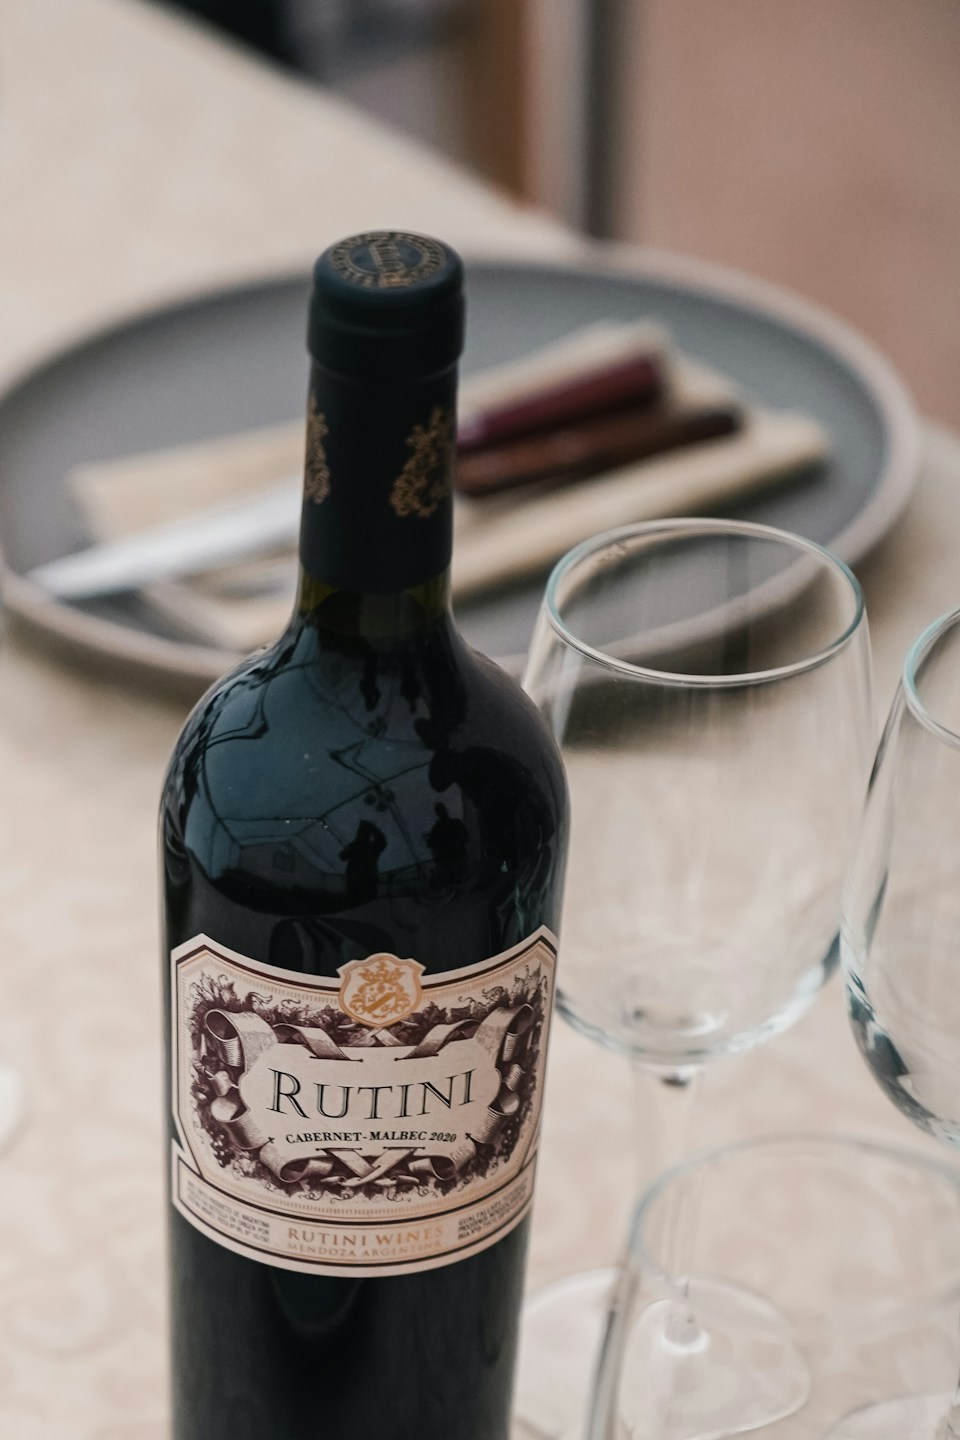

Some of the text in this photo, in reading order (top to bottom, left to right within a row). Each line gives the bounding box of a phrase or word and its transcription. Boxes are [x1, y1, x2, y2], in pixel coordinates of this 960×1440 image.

[266, 1067, 477, 1120] RUTINI
[428, 1131, 457, 1143] 2020
[287, 1224, 444, 1247] RUTINI WINES
[287, 1242, 356, 1257] MENDOZA
